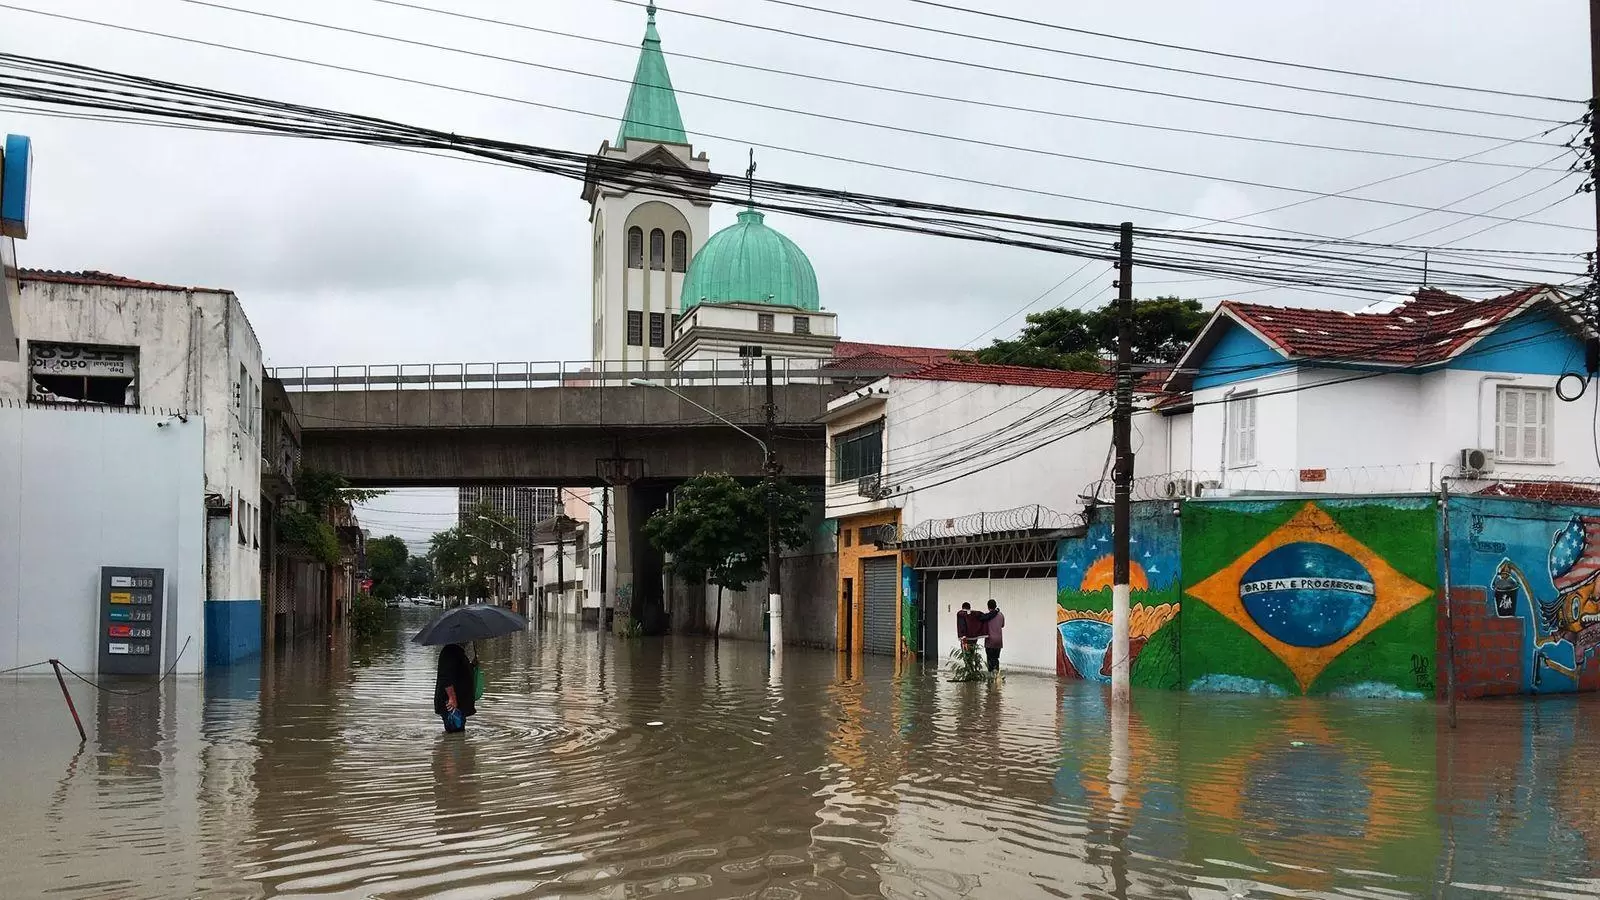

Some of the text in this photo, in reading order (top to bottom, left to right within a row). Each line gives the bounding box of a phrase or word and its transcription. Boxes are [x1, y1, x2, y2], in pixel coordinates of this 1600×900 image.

[1244, 579, 1363, 592] ORDEM E PROGRESSO
